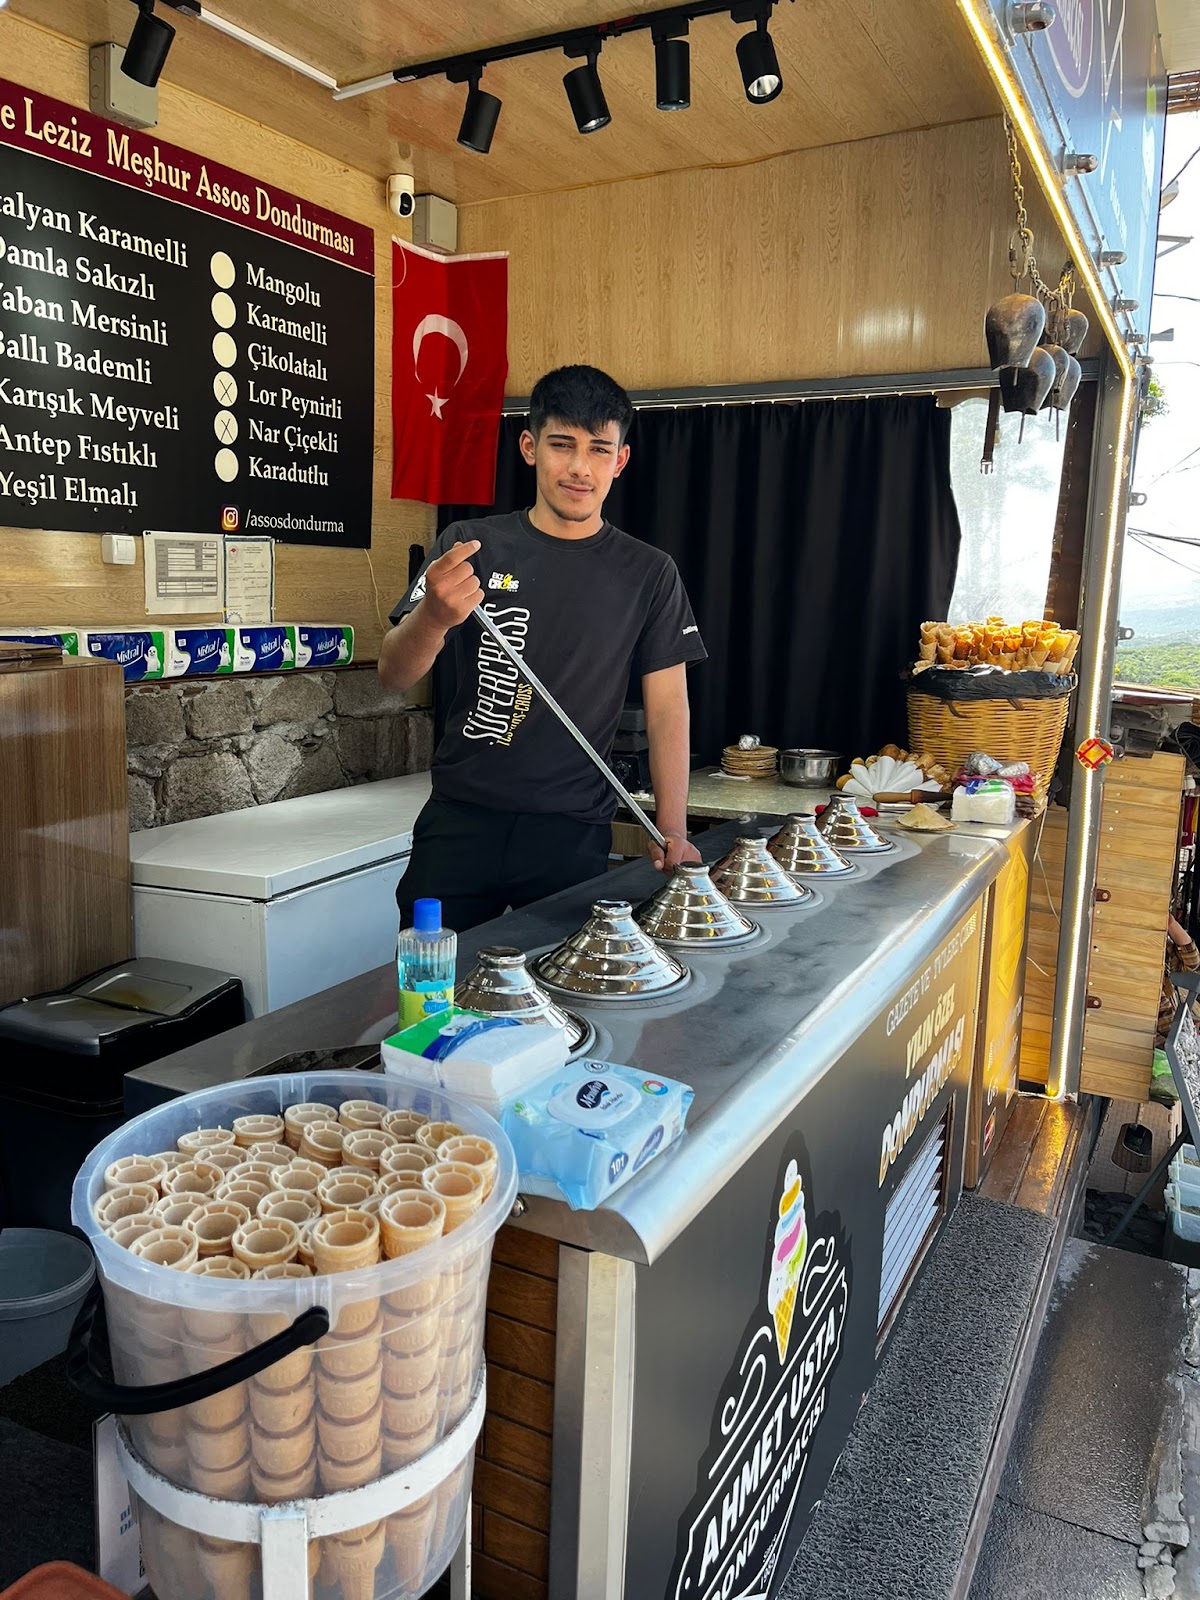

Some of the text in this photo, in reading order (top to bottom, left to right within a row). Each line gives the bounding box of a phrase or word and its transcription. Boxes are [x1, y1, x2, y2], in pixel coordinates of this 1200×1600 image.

[23, 96, 92, 158] Leziz
[107, 128, 191, 192] Meşhur
[196, 165, 251, 216] Assos
[255, 187, 355, 256] Dondurması
[78, 211, 189, 268] Karamelli
[76, 256, 156, 301] Sakızlı
[246, 262, 322, 308] Mangolu
[71, 300, 169, 347] Mersinli
[246, 302, 328, 346] Karamelli
[55, 342, 153, 385] Bademli
[247, 342, 328, 381] Çikolatalı
[0, 378, 180, 432] Karışık Meyveli
[248, 381, 343, 420] Lor Peynirli
[0, 424, 158, 469] Antep Fıstıklı
[249, 418, 339, 453] Nar Çiçekli
[0, 471, 138, 507] Yeşil Elmalı
[249, 456, 329, 486] Karadutlu
[245, 509, 345, 533] /assosdondurma
[116, 644, 141, 664] Mistral
[904, 982, 956, 1080] YILIN ÖZEL
[878, 1013, 966, 1189] DONDURMASI
[610, 1155, 626, 1177] 101
[698, 1305, 837, 1587] AHMET USTA
[711, 1386, 827, 1600] ONDURMACISI
